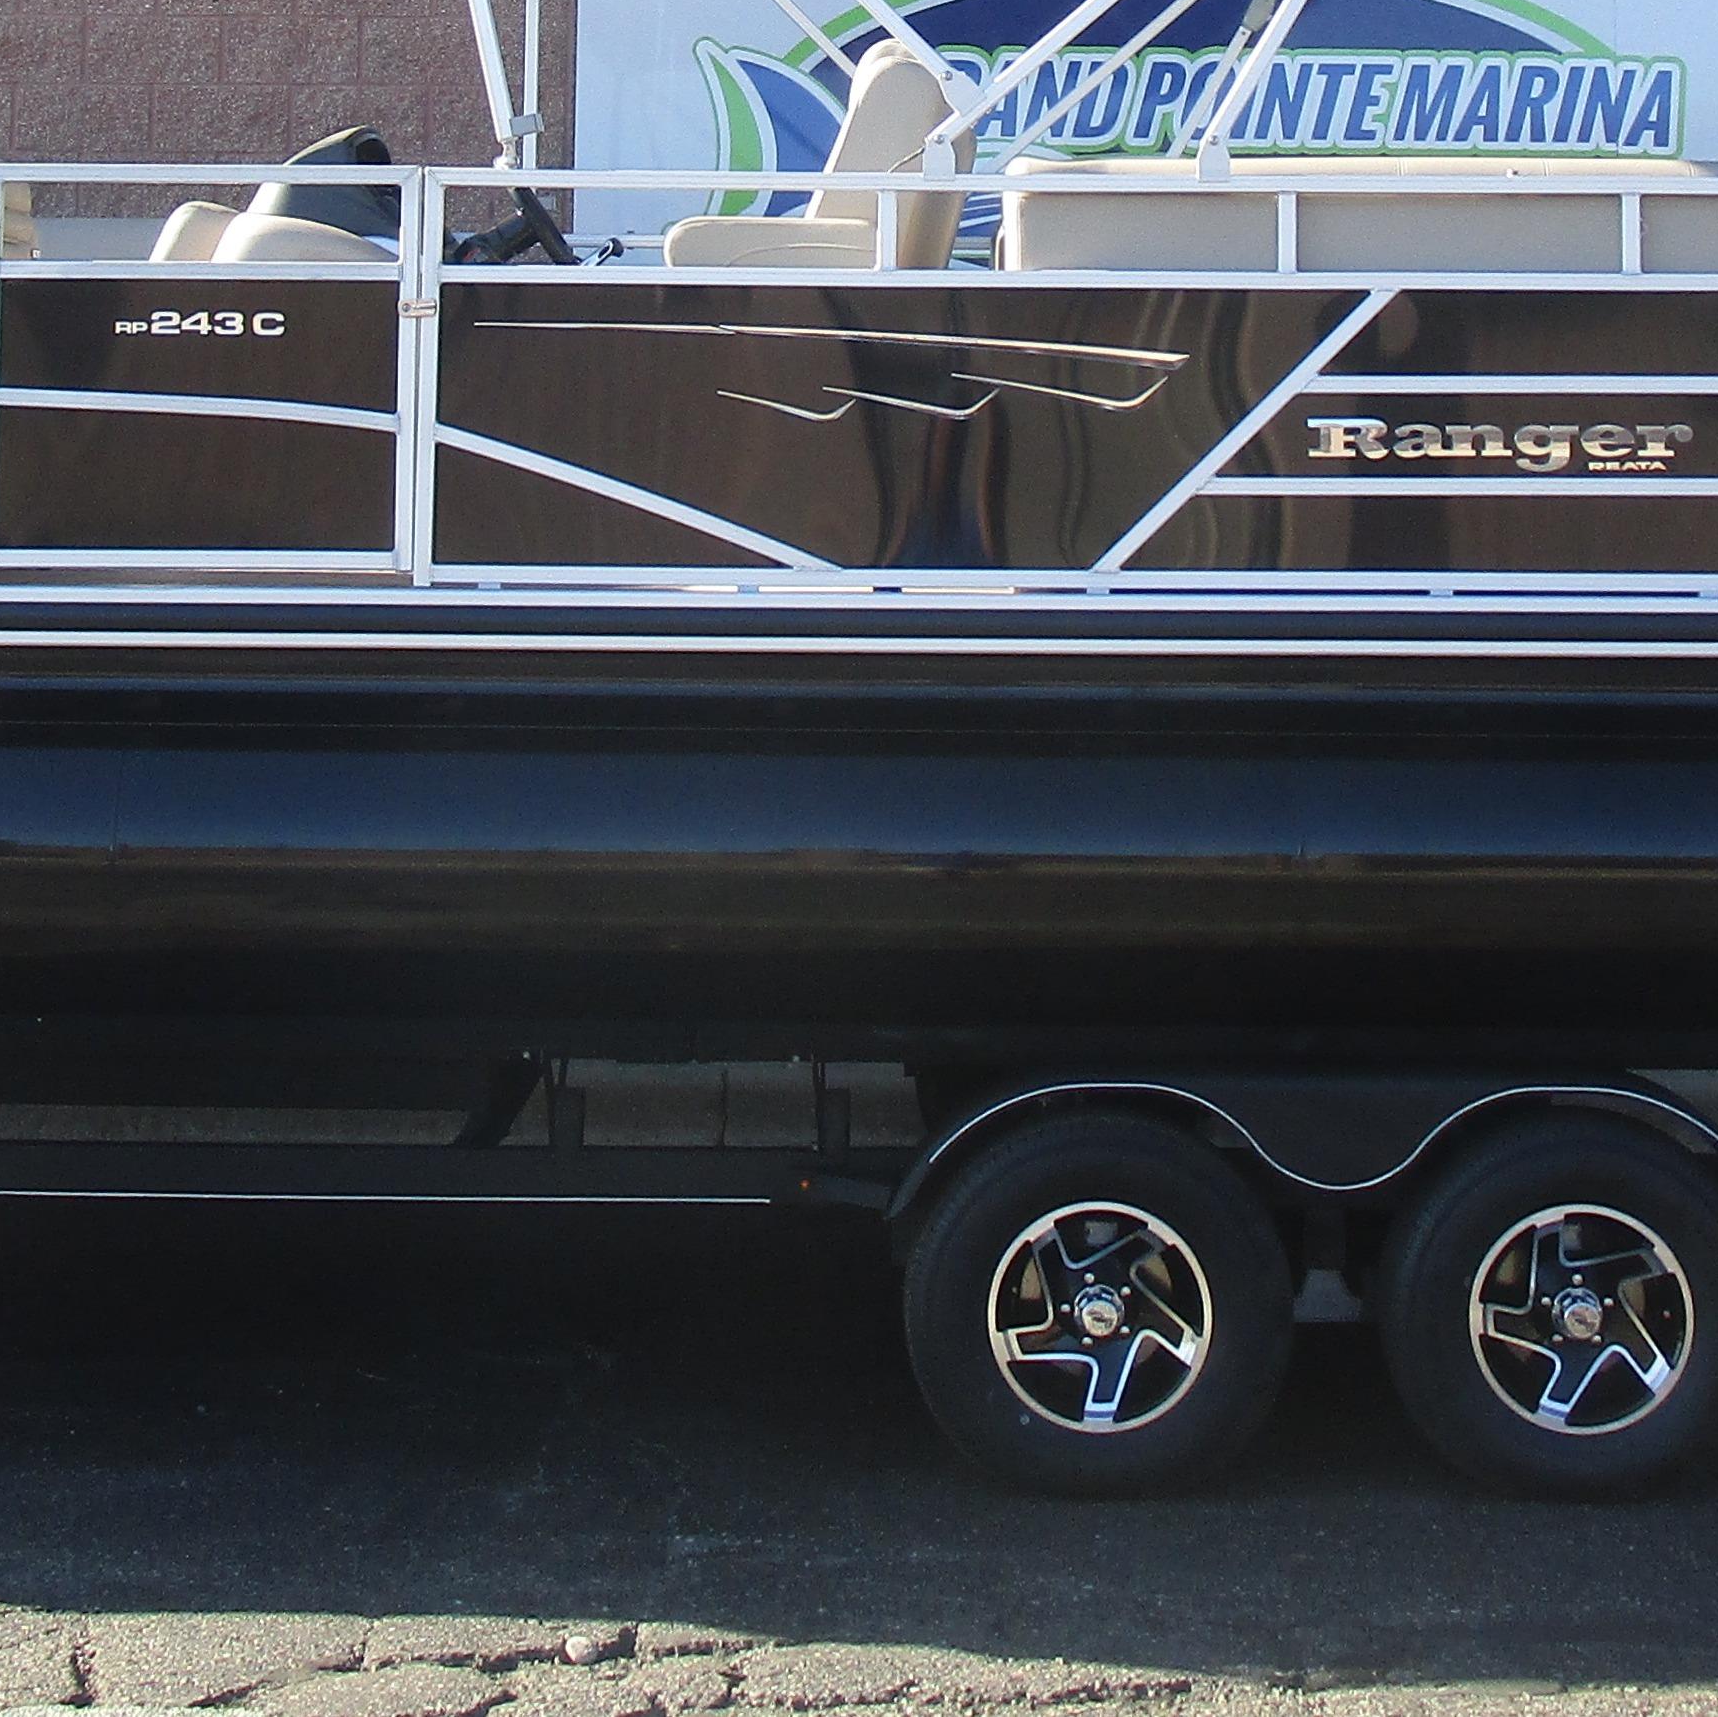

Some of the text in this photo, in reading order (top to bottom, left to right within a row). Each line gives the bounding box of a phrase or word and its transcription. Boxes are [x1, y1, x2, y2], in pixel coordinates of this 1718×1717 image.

[1394, 63, 1675, 148] MARINA
[1306, 416, 1694, 472] Ranger
[1588, 461, 1667, 472] REATA
